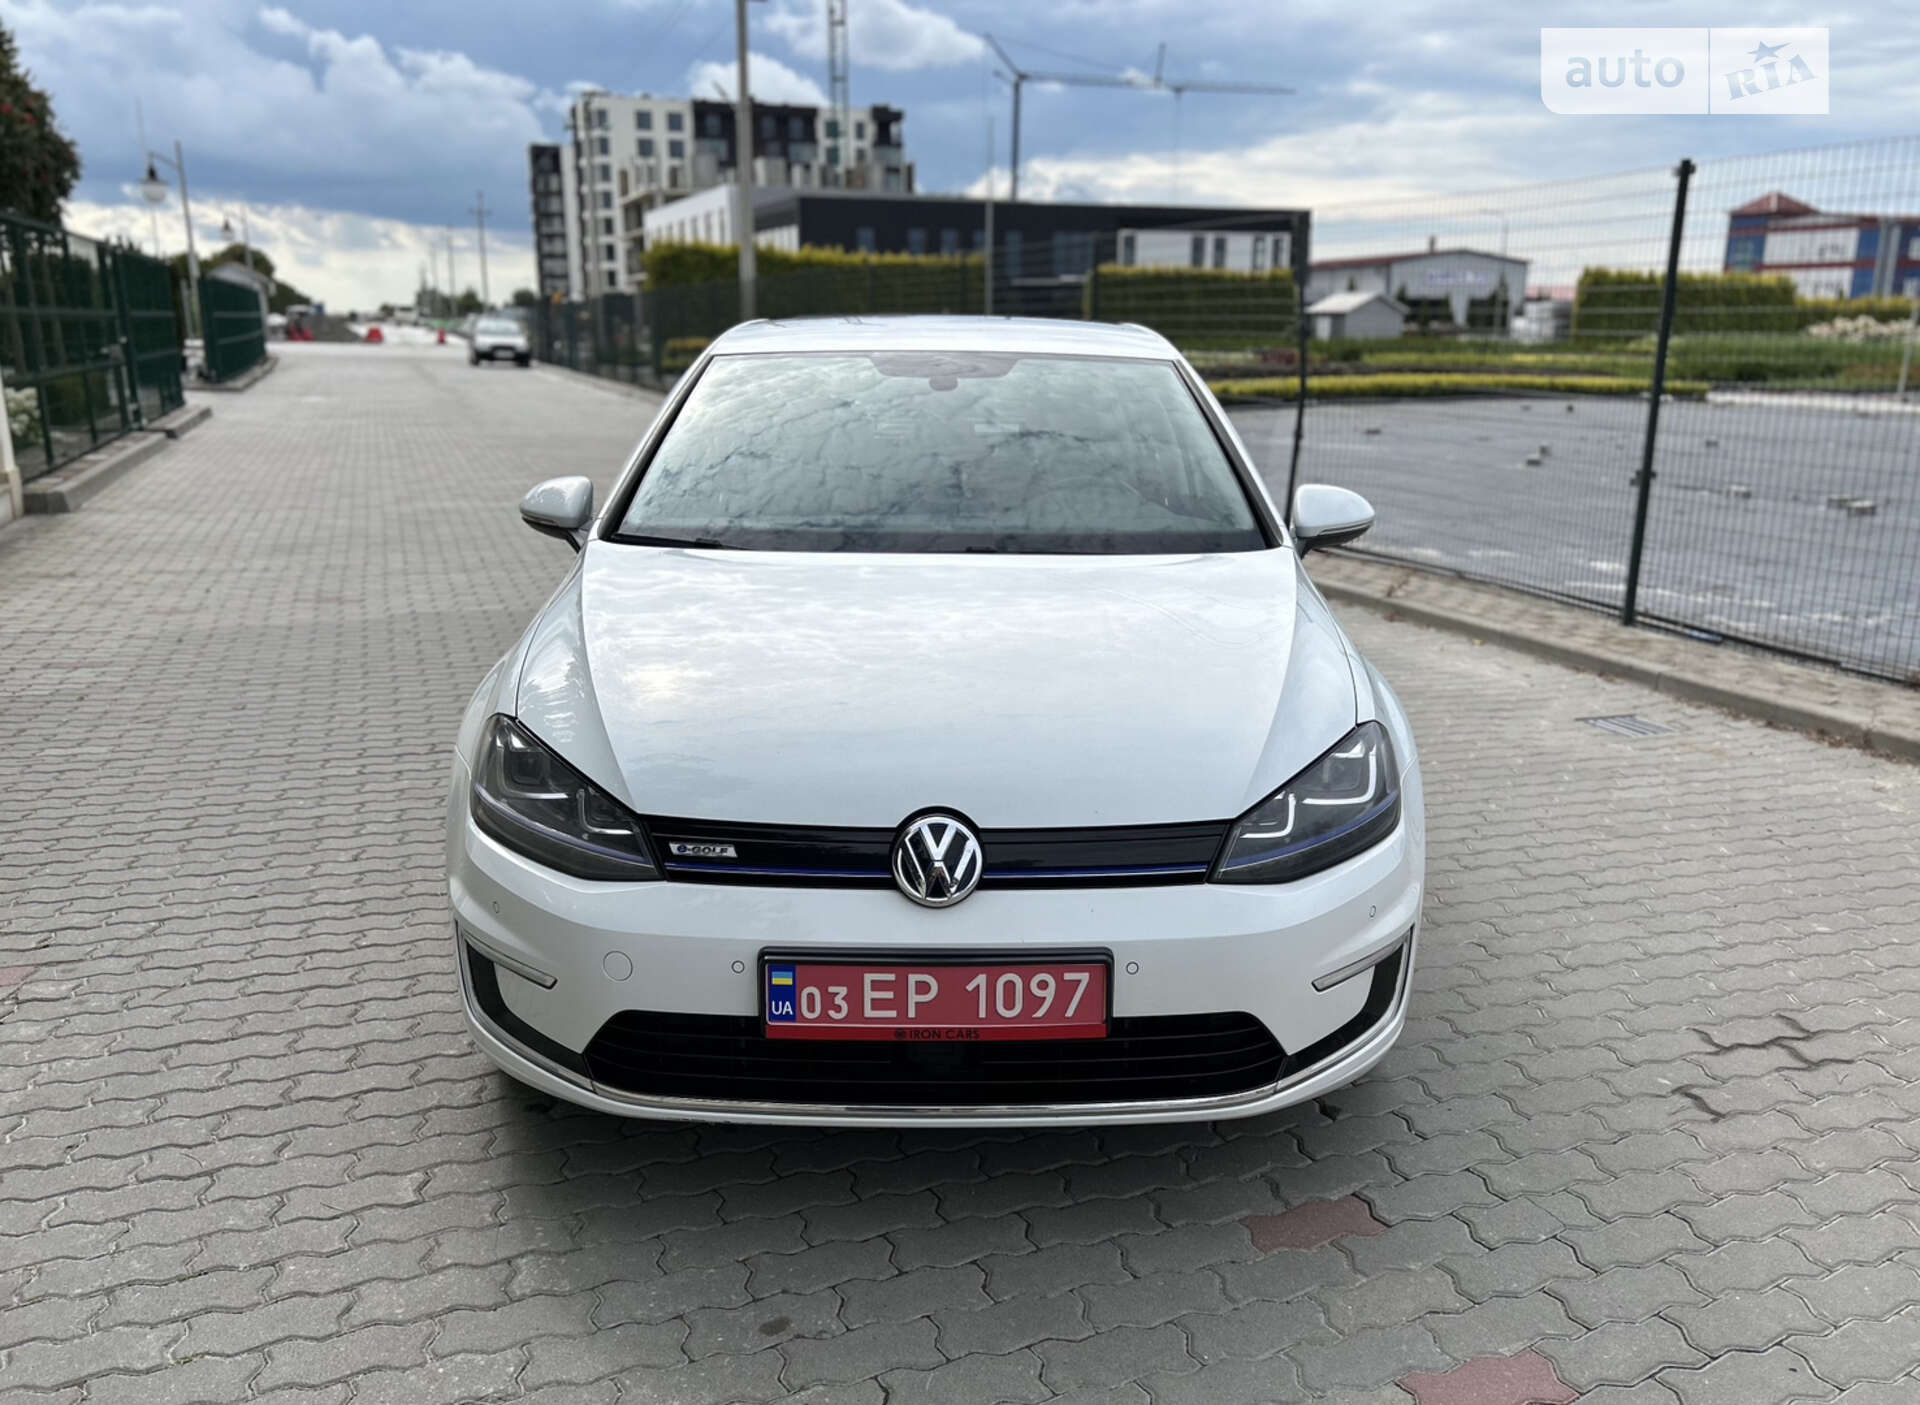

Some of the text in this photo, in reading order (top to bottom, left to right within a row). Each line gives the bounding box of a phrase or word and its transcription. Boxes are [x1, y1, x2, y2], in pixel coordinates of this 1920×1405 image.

[897, 816, 979, 903] VW
[771, 1001, 793, 1016] UA
[800, 972, 1090, 1020] 03 EP 1097
[909, 1029, 980, 1040] IRON CARS
